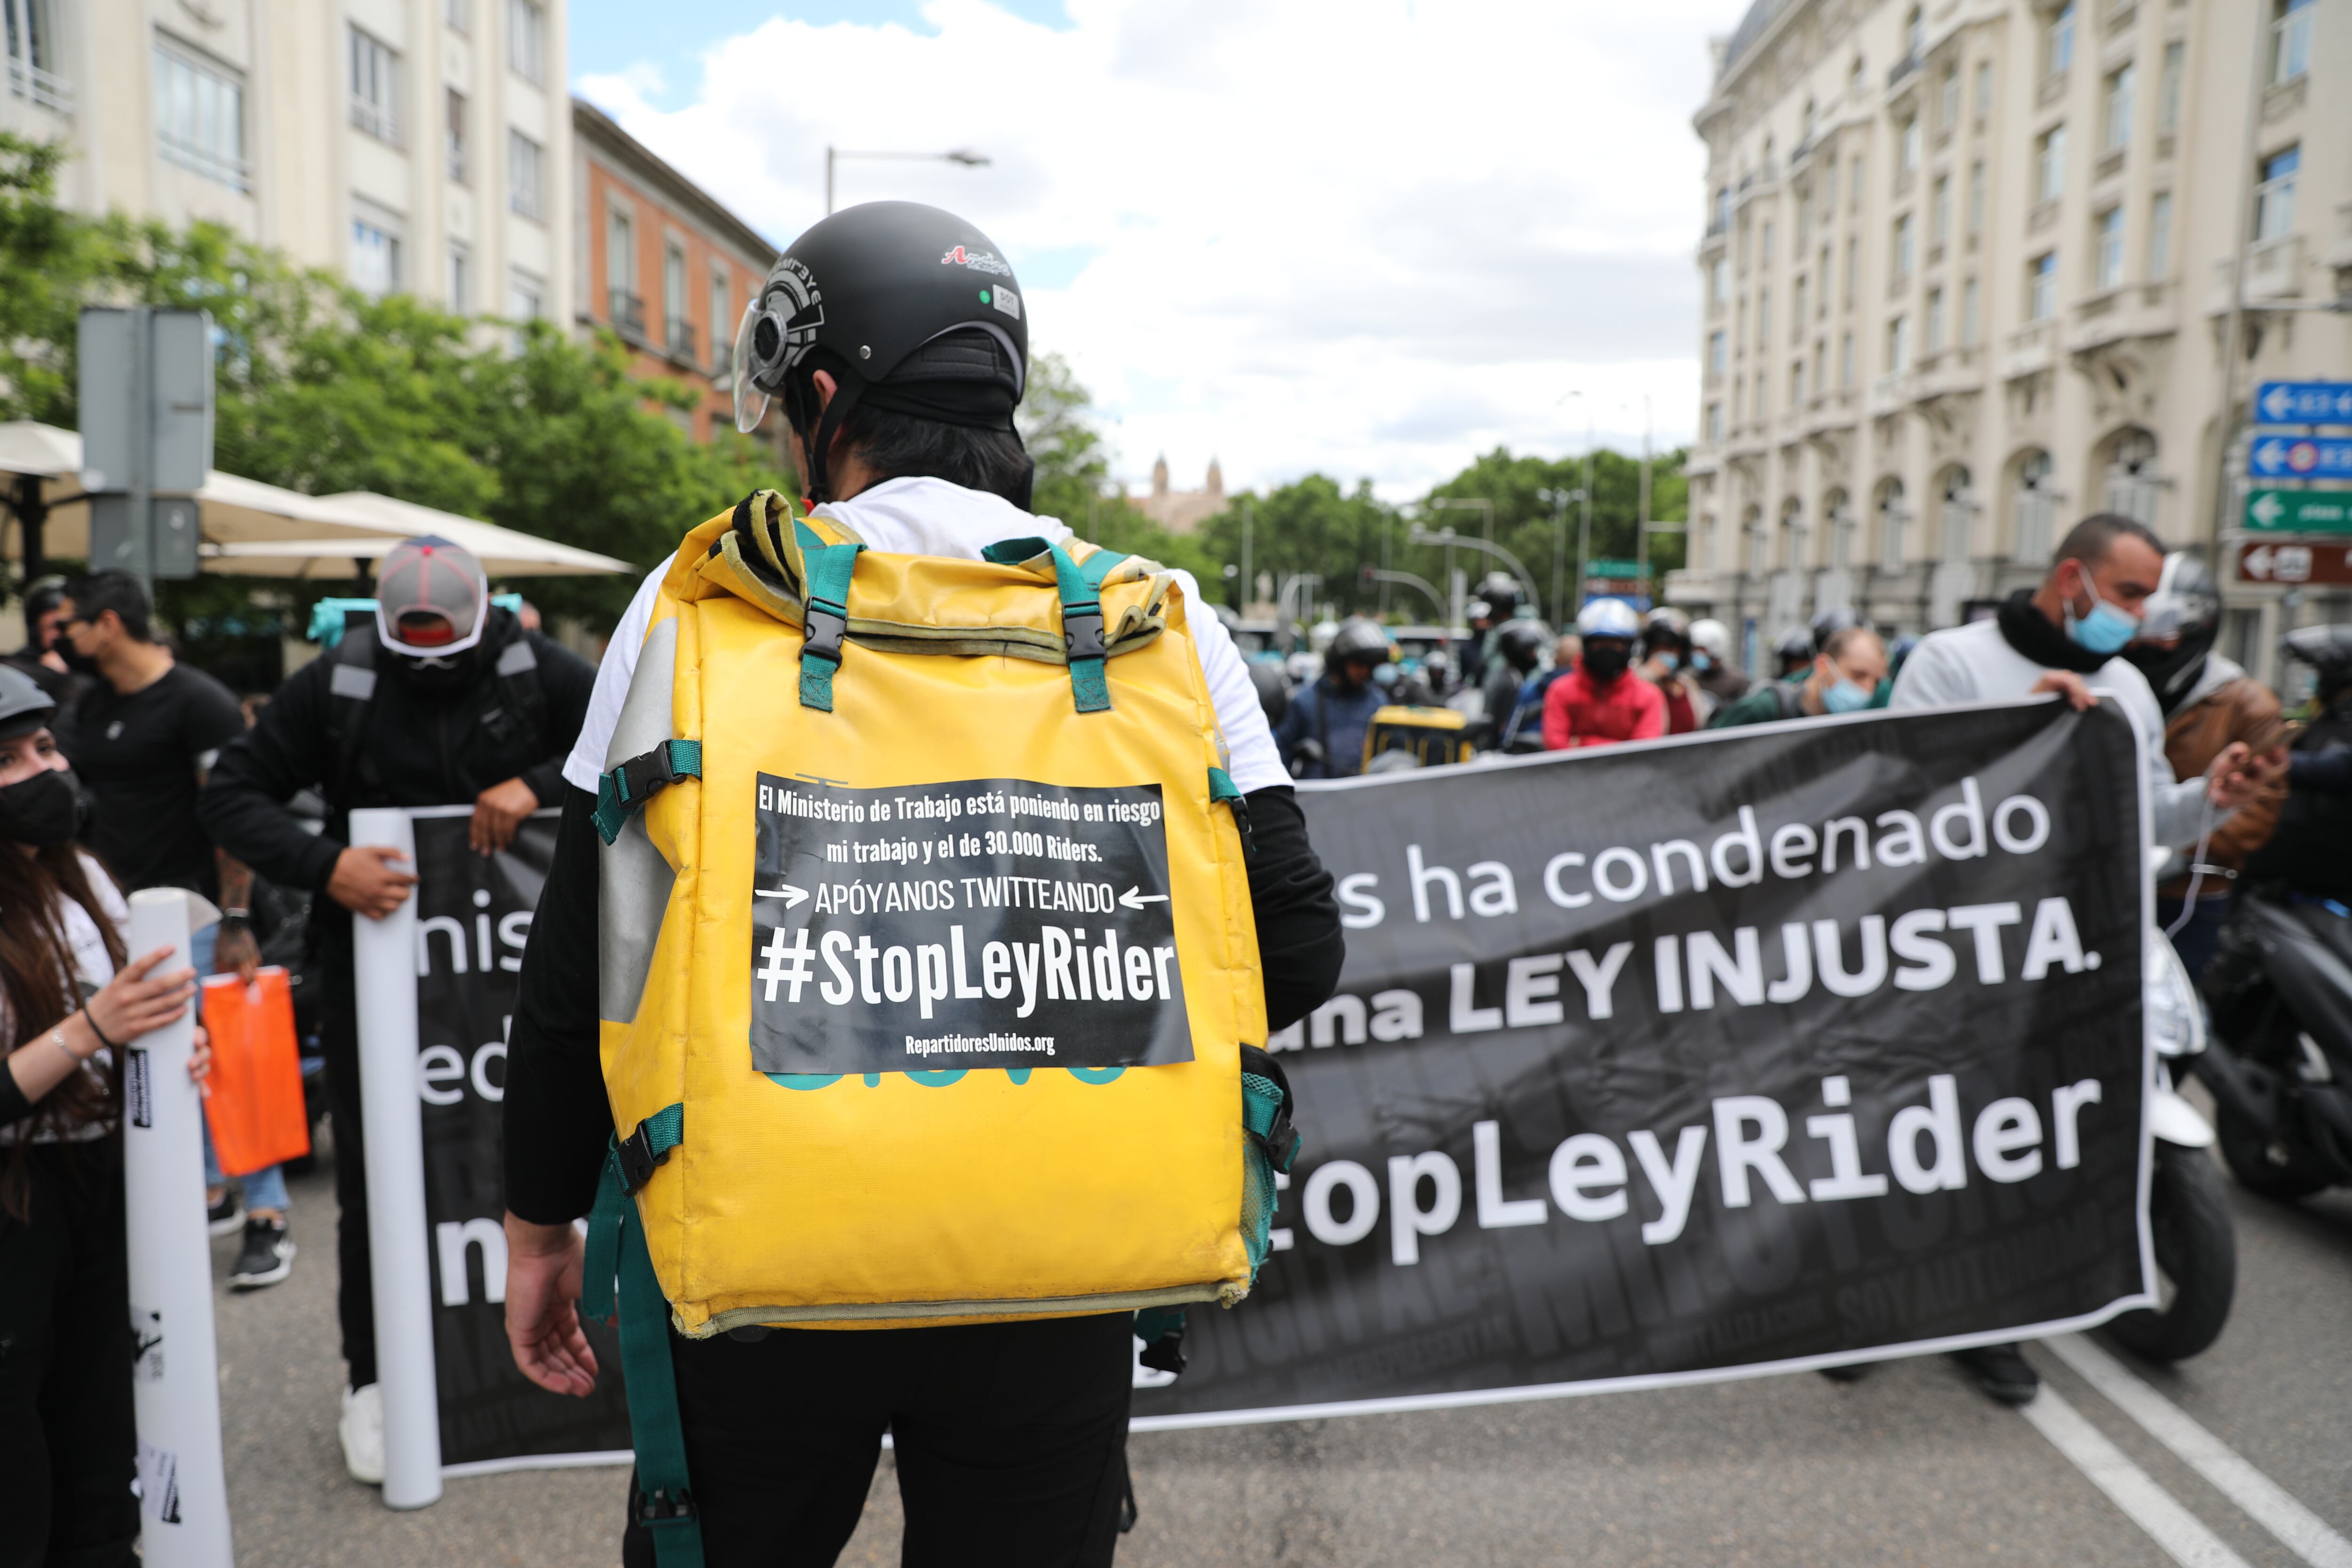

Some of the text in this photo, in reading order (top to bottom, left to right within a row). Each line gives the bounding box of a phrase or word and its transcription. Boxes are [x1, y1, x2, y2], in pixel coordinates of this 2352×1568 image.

[759, 785, 1160, 827] El Ministerio de Trabajo está poniendo en riesgo
[826, 830, 1103, 866] mi trabajo y el de 30.000 Riders.
[1406, 844, 1519, 923] ha
[1543, 777, 2050, 909] condenado
[814, 876, 1115, 914] APÓYANOS TWITTEANDO
[756, 924, 1176, 1020] #StopLeyRider
[1451, 944, 1631, 1033] LEY
[1655, 898, 2100, 1013] INJUSTA.
[905, 1033, 1056, 1058] RepartidoresUnidos.org
[1269, 1075, 2100, 1266] opLeyRider
